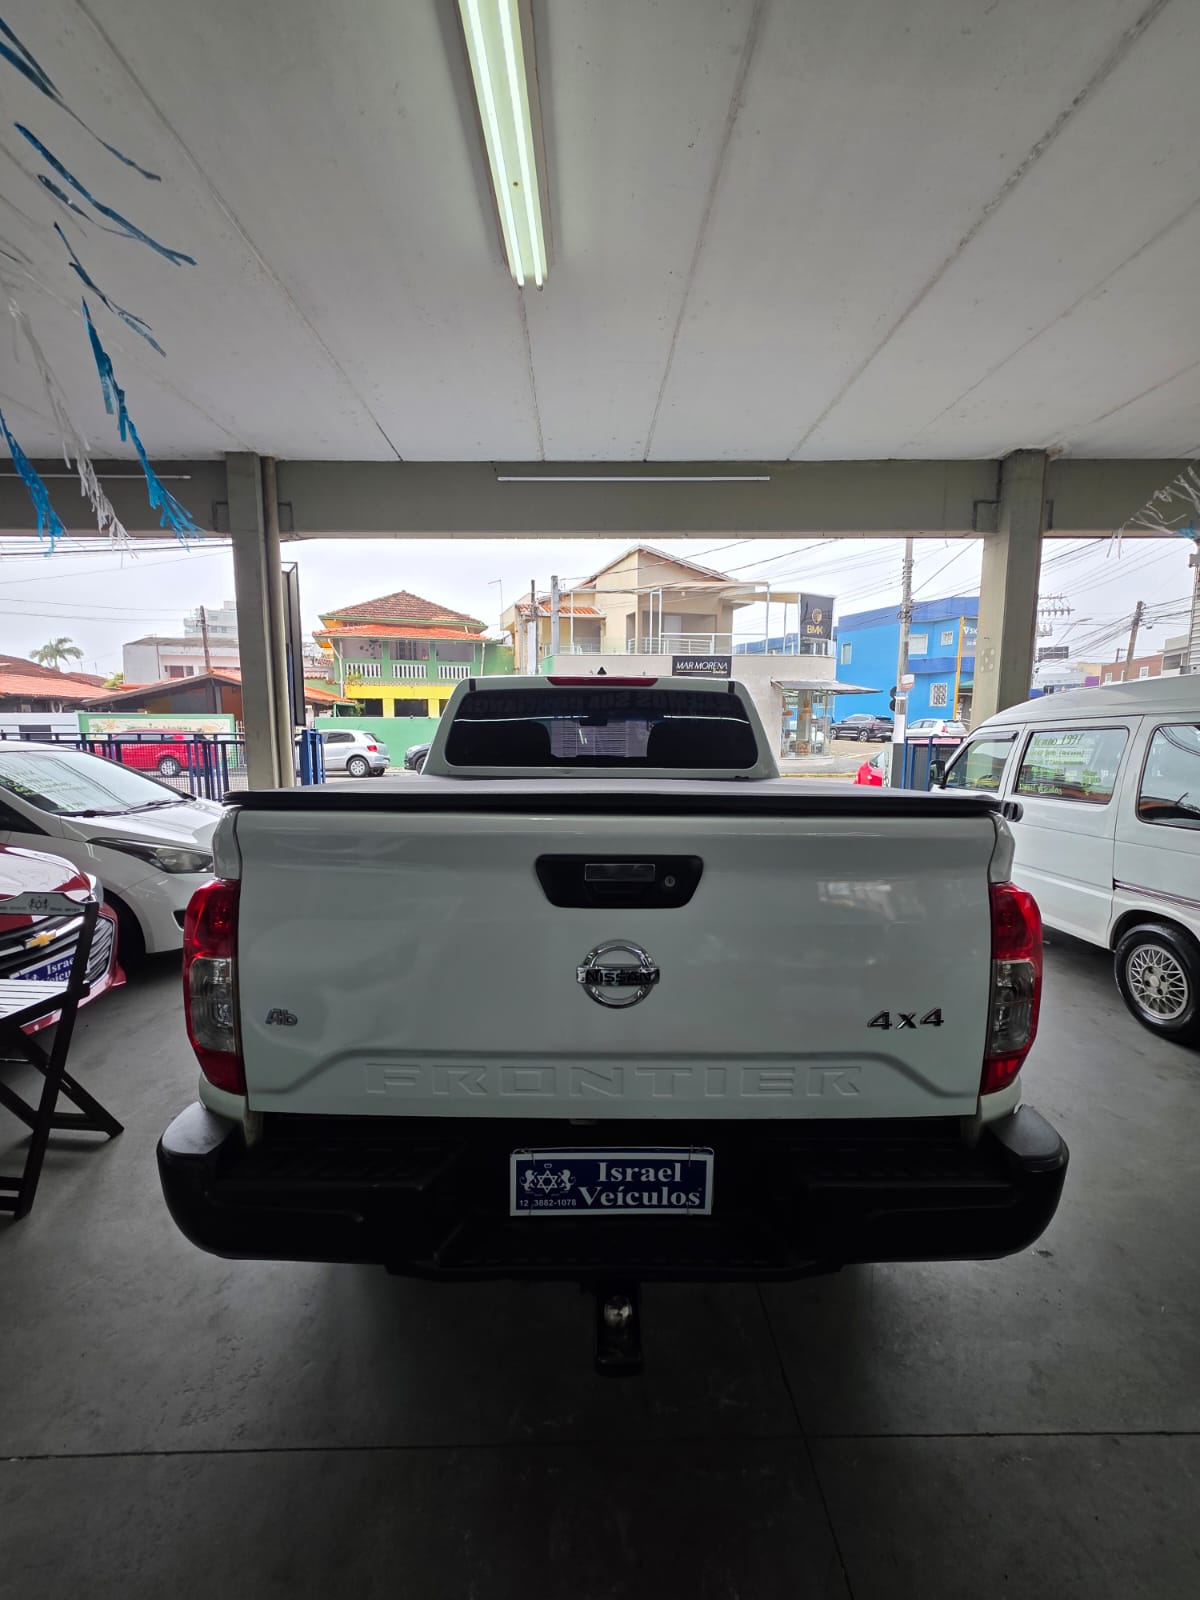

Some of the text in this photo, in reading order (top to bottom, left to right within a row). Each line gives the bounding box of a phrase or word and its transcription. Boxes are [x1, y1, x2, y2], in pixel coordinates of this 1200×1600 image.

[806, 624, 823, 635] BMK
[676, 661, 728, 670] MAR MORENA
[585, 968, 652, 984] NISSAN
[867, 1008, 944, 1030] 4x4
[365, 1063, 861, 1097] FRONTIER
[597, 1162, 682, 1182] Israel
[520, 1199, 529, 1207] 12
[578, 1187, 700, 1207] Veículos
